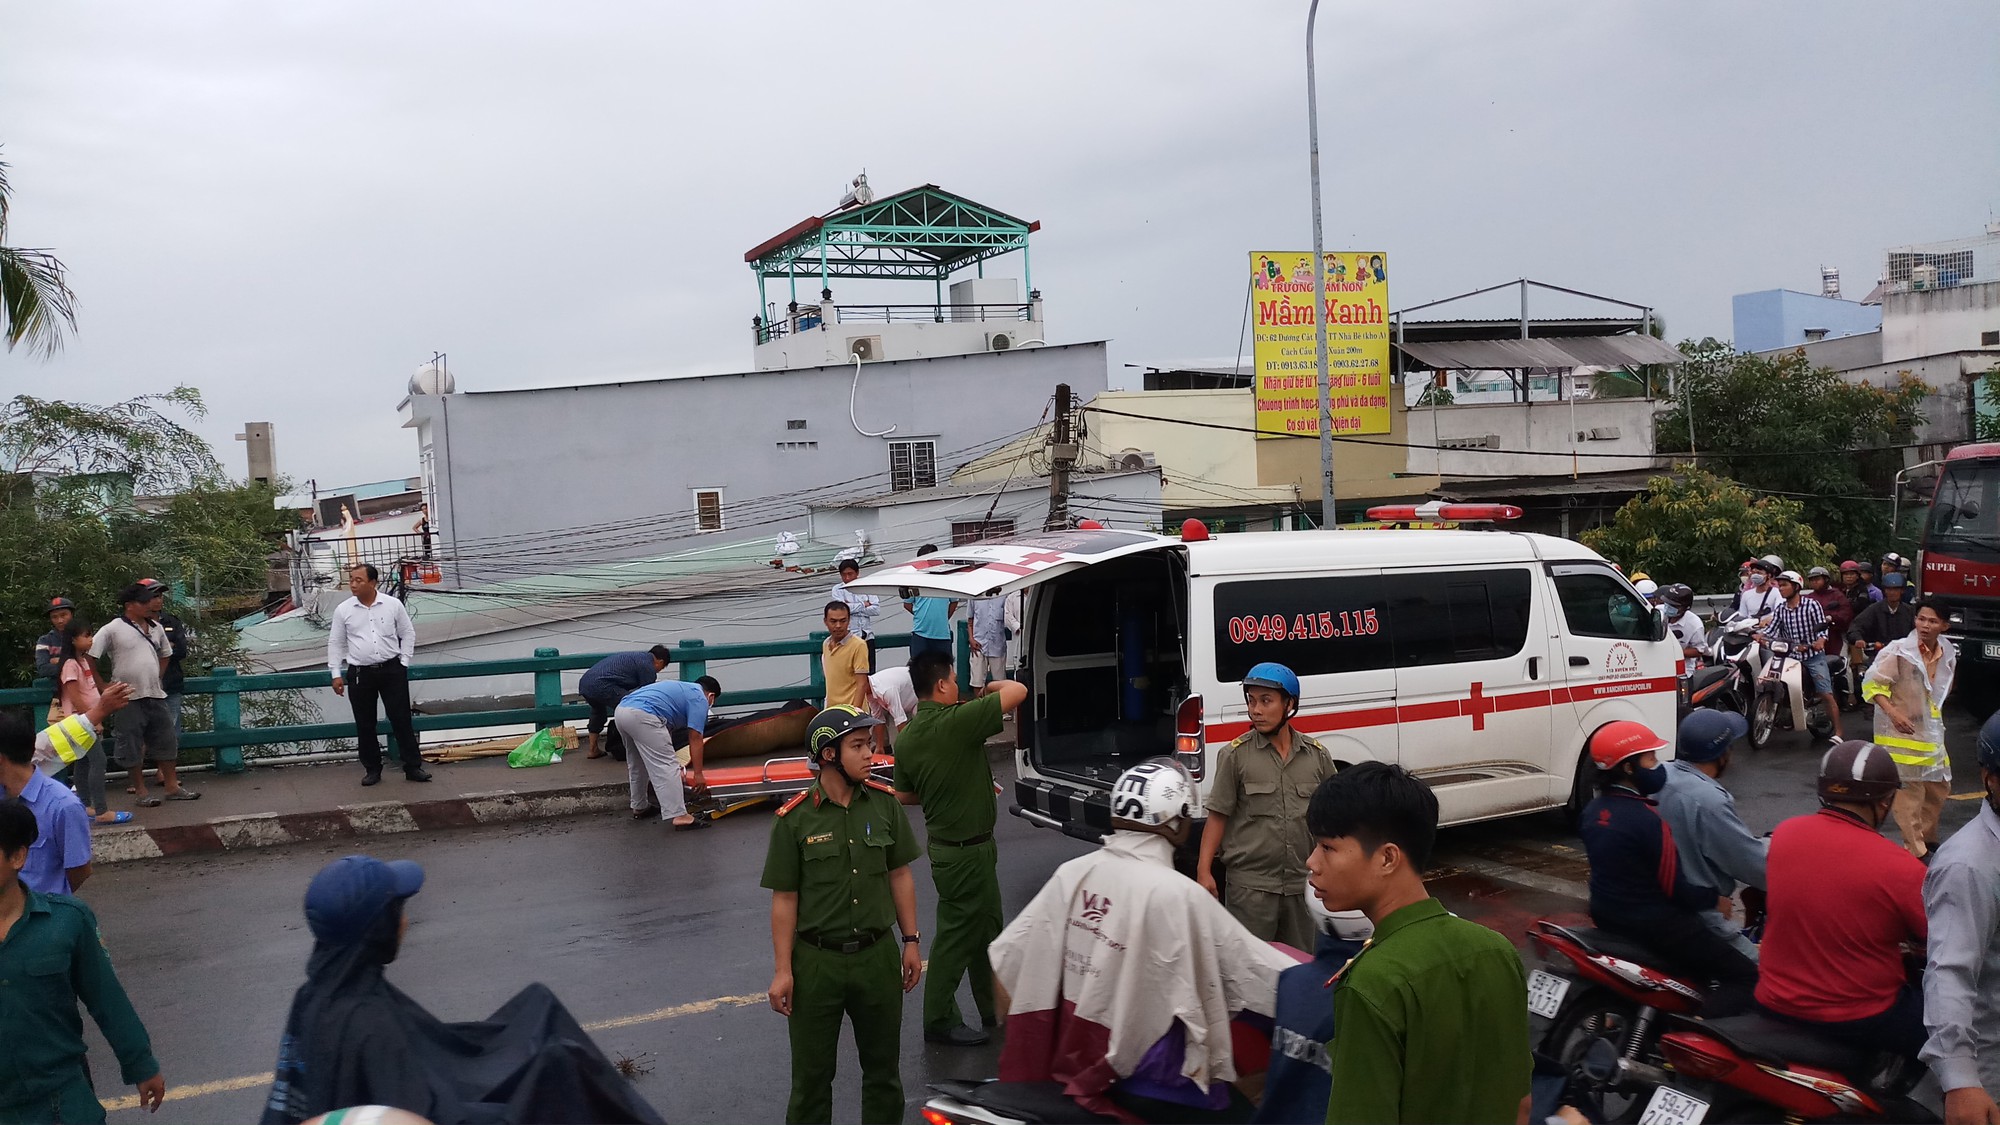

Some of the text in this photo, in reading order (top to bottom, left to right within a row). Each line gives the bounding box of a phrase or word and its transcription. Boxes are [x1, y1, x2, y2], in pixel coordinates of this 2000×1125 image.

[1341, 282, 1363, 292] NON
[1258, 294, 1383, 326] Mầm Xanh
[1269, 333, 1277, 342] 62
[1328, 332, 1337, 341] TT
[1378, 331, 1387, 340] A)
[1346, 345, 1363, 354] 200m
[1266, 361, 1280, 370] ĐT:
[1280, 360, 1318, 370] 0913.63.18
[1333, 358, 1379, 369] 0903.62.27.68
[1361, 373, 1367, 386] 6
[1925, 562, 1956, 572] SUPER
[1228, 607, 1379, 645] 0949.415.115
